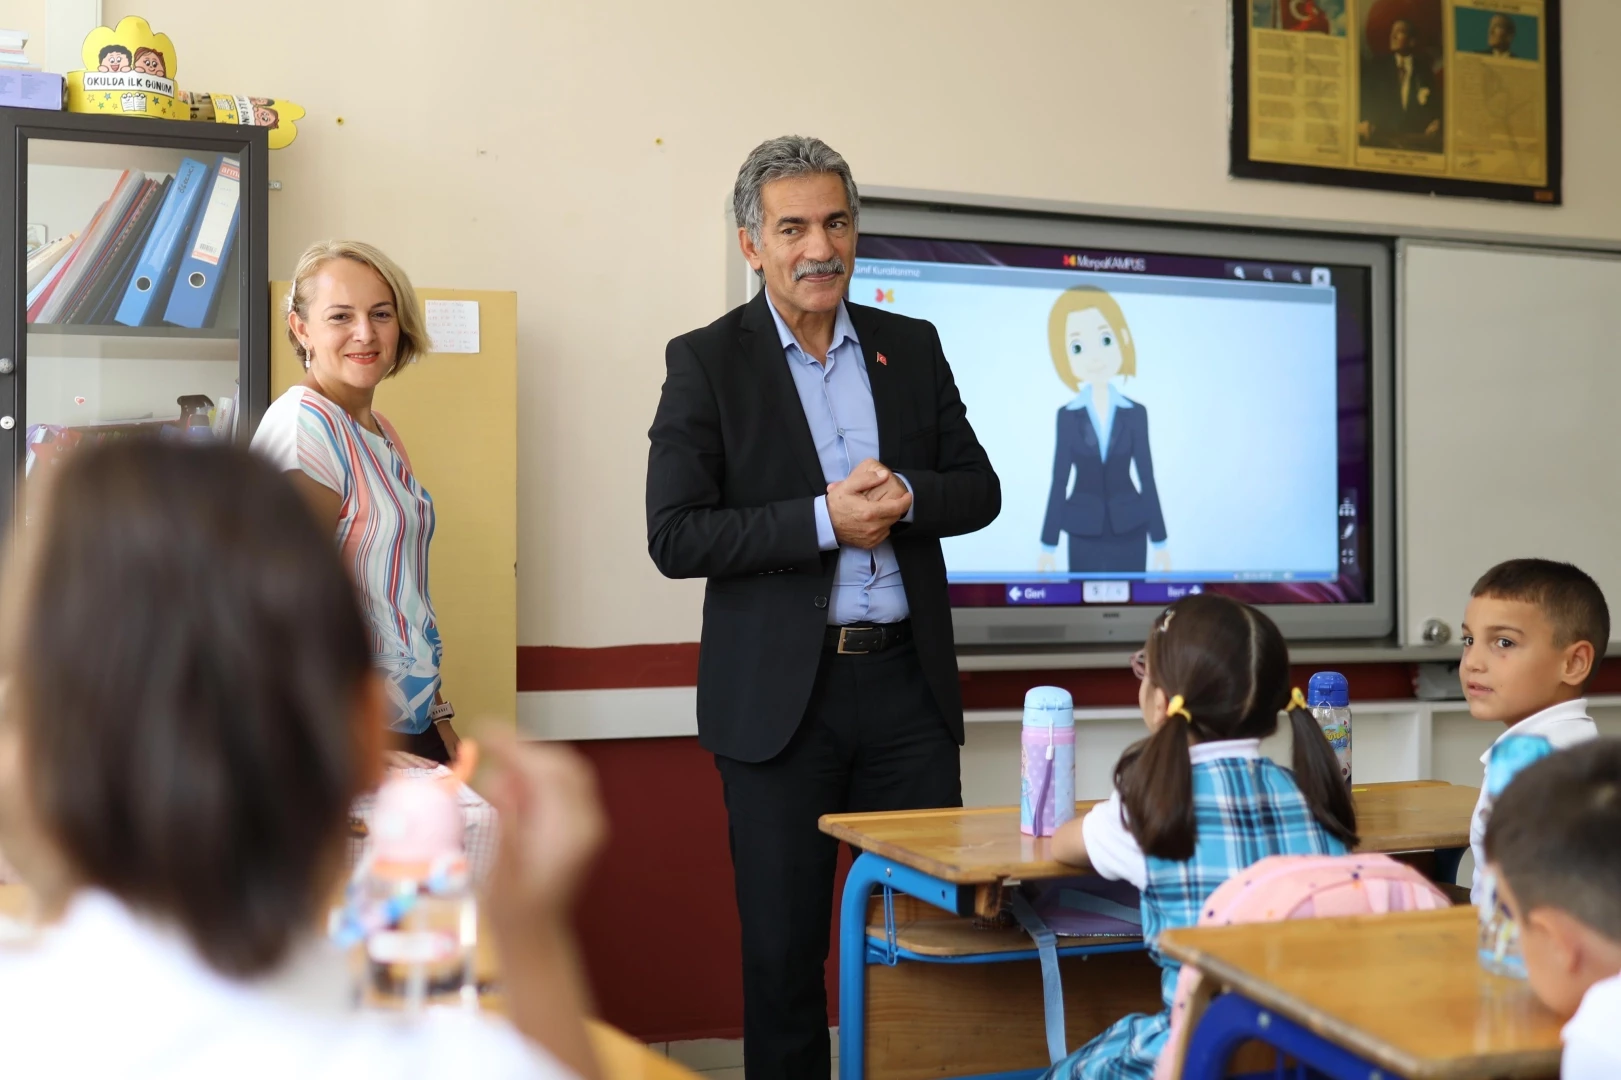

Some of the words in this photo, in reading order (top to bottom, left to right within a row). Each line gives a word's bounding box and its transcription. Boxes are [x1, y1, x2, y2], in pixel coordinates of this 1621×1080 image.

[87, 77, 125, 87] OKULDA
[128, 76, 143, 88] İLK
[145, 79, 172, 95] GÜNÜM
[1024, 587, 1047, 600] Geri
